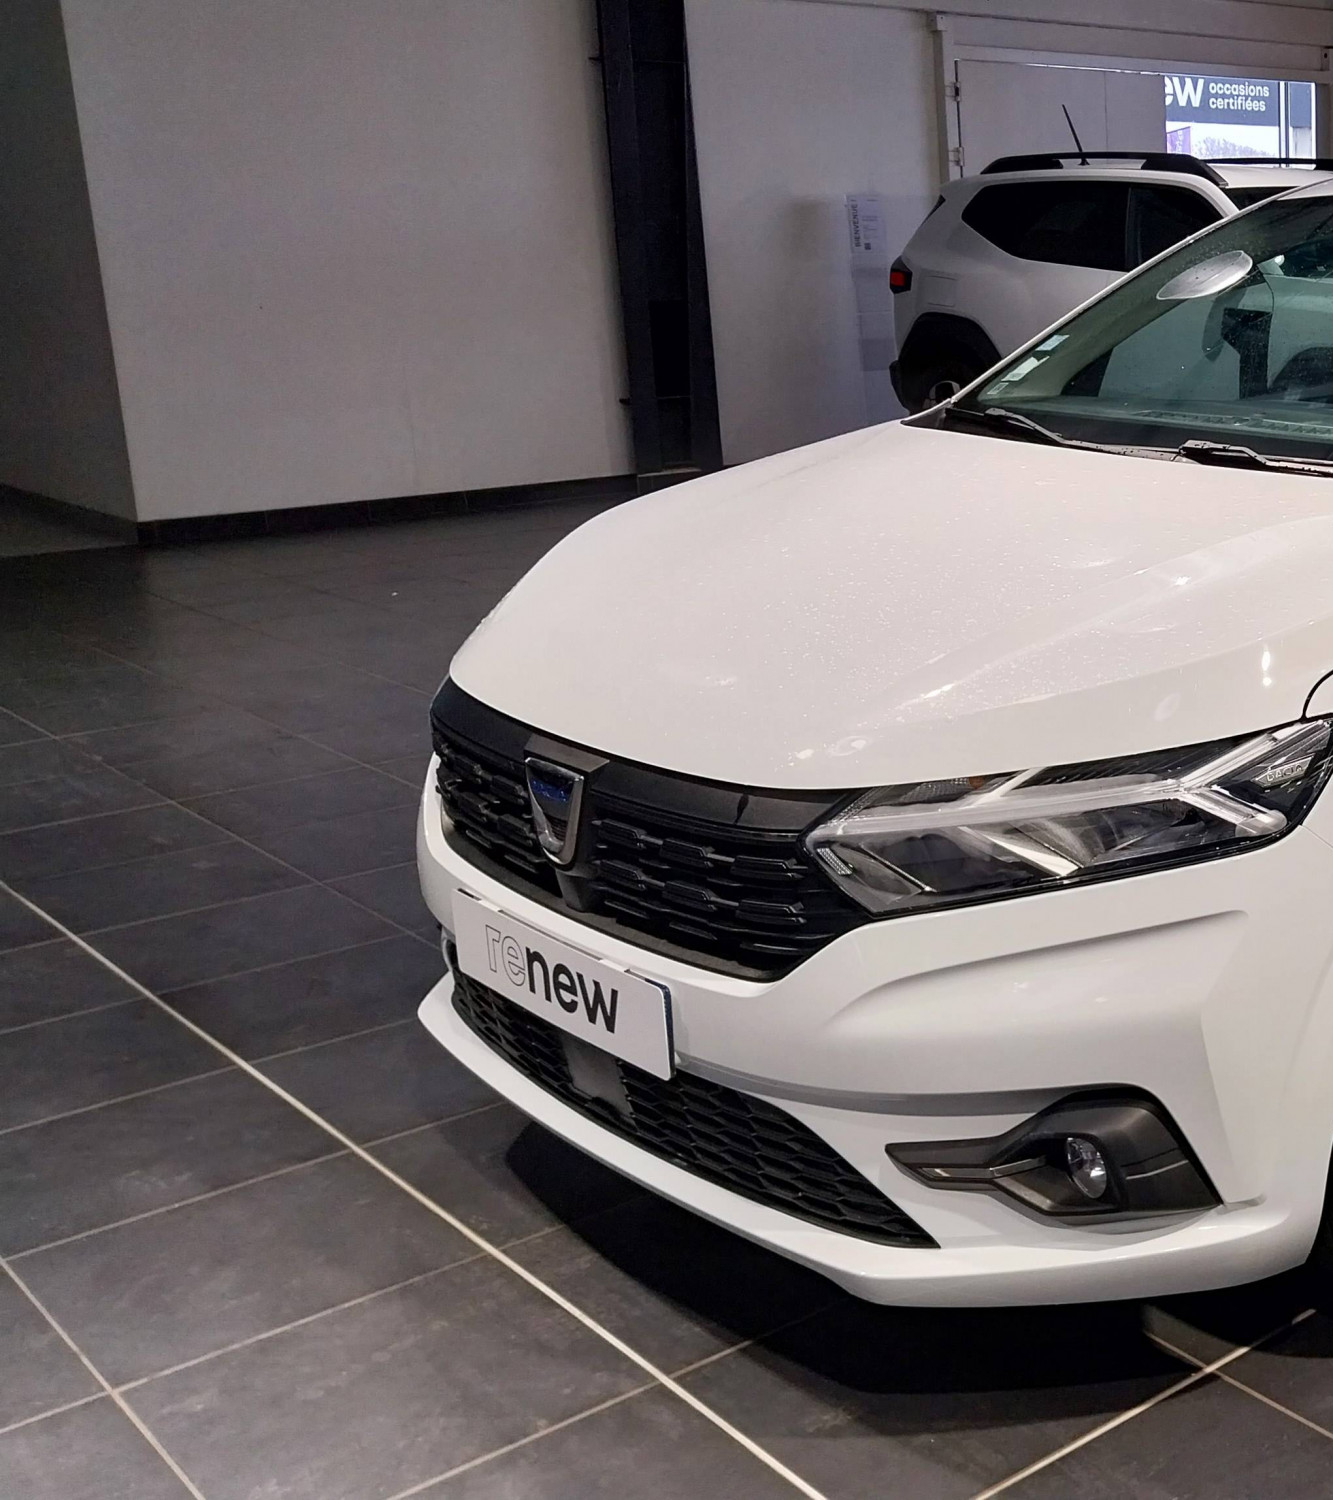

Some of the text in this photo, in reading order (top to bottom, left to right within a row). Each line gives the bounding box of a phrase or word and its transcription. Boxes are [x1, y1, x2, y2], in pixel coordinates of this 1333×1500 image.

[1209, 81, 1270, 97] occasions
[1209, 96, 1266, 111] certifiées
[850, 204, 861, 248] BIENVENUE
[1266, 764, 1303, 782] DACIA
[485, 924, 618, 1034] renew
